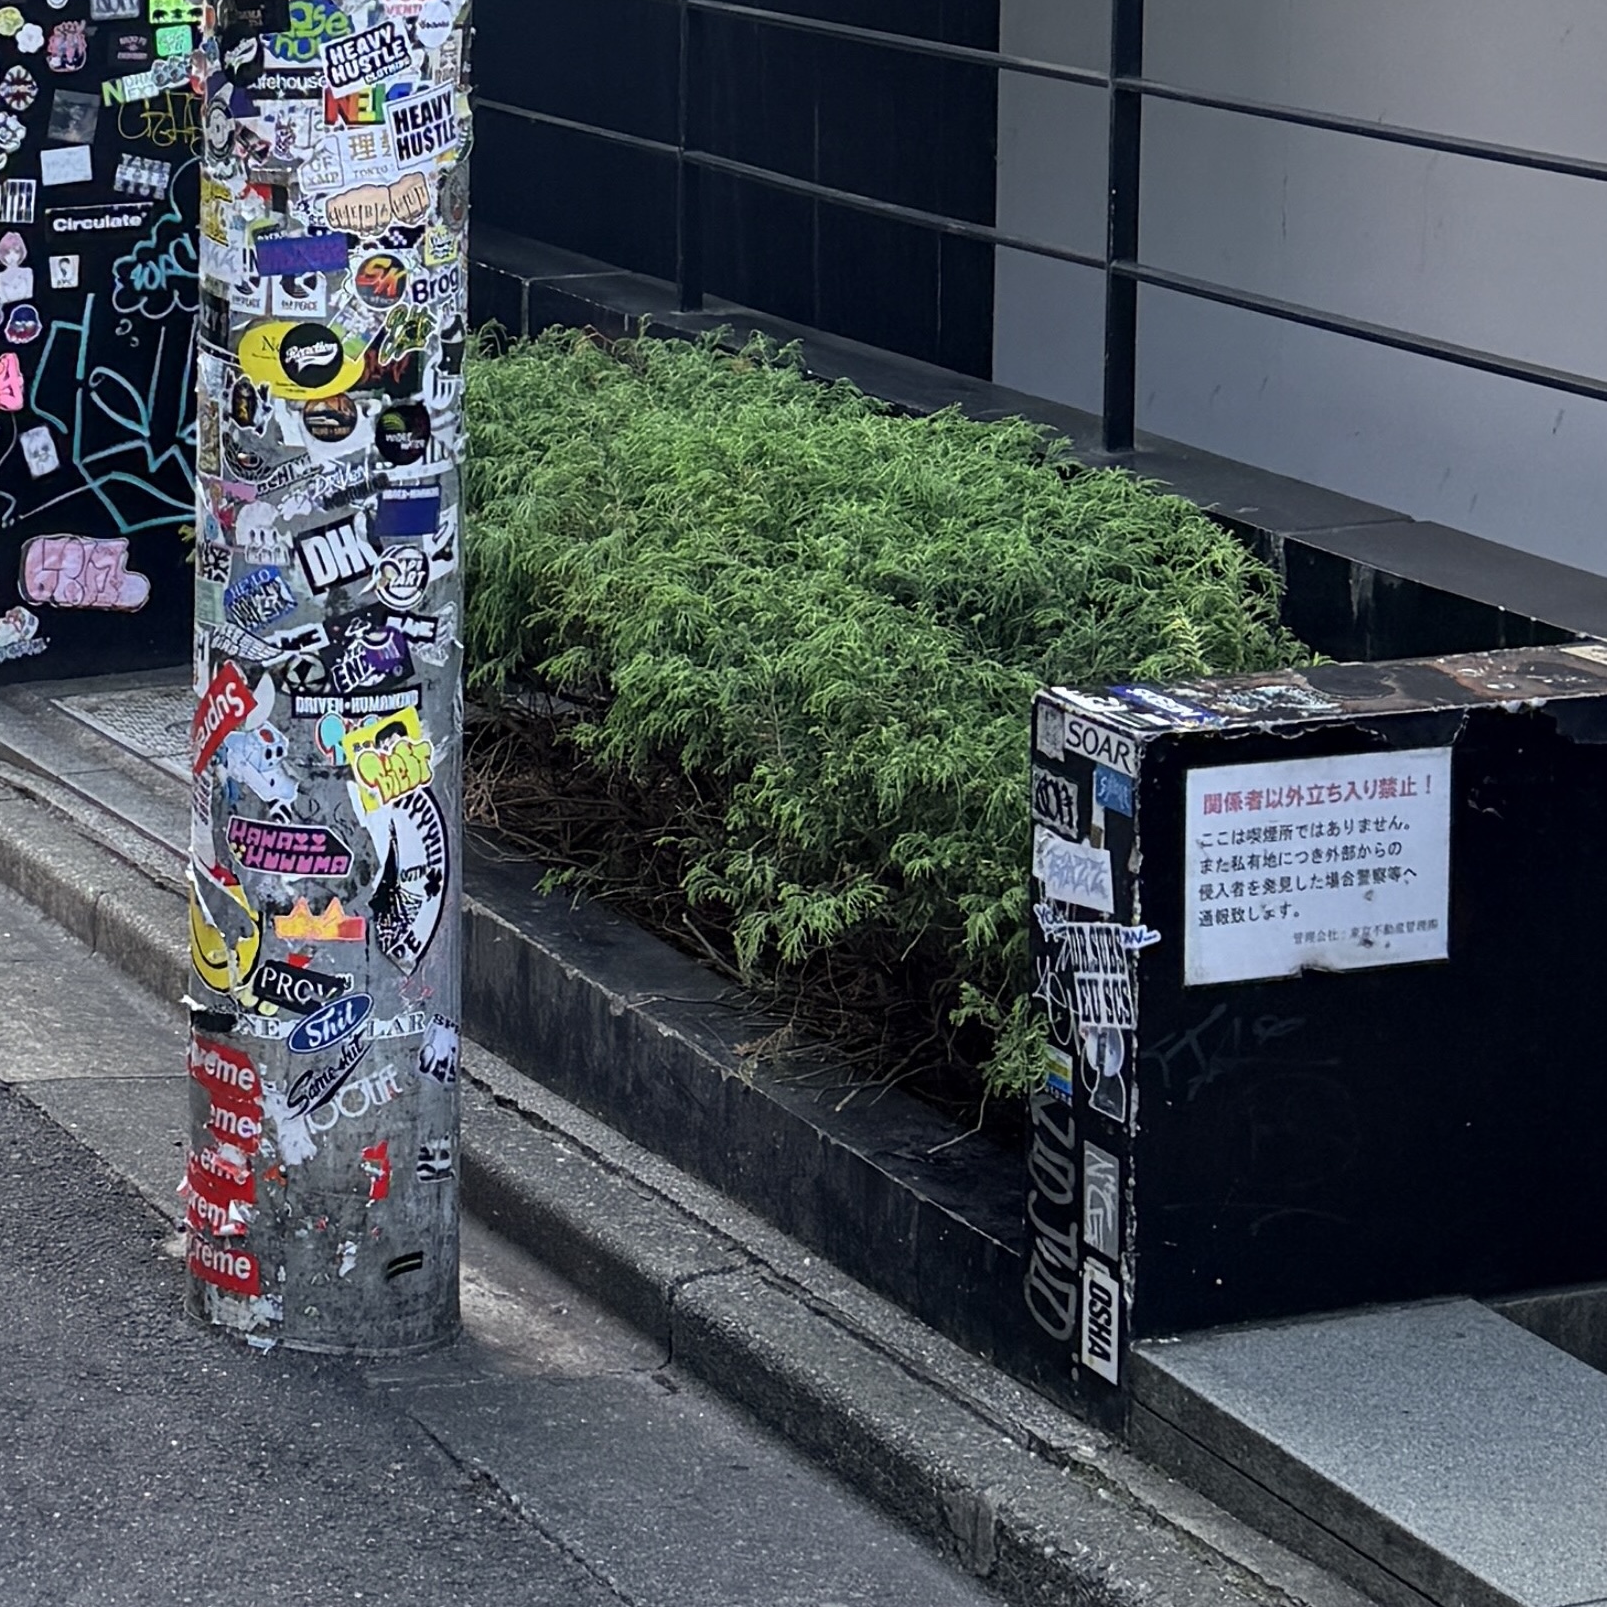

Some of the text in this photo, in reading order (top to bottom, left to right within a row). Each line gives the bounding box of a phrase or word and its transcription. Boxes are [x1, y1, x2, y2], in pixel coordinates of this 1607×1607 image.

[329, 24, 395, 66] HEAVY
[331, 41, 407, 86] HUSTLE
[392, 91, 453, 136] HEAVY
[53, 215, 142, 233] Circulate
[295, 696, 344, 713] DRIVEN
[1065, 721, 1132, 774] SOAR
[1200, 815, 1411, 849] ここは喫煙所ではありません。
[1199, 840, 1403, 874] また私有地につき外部からの
